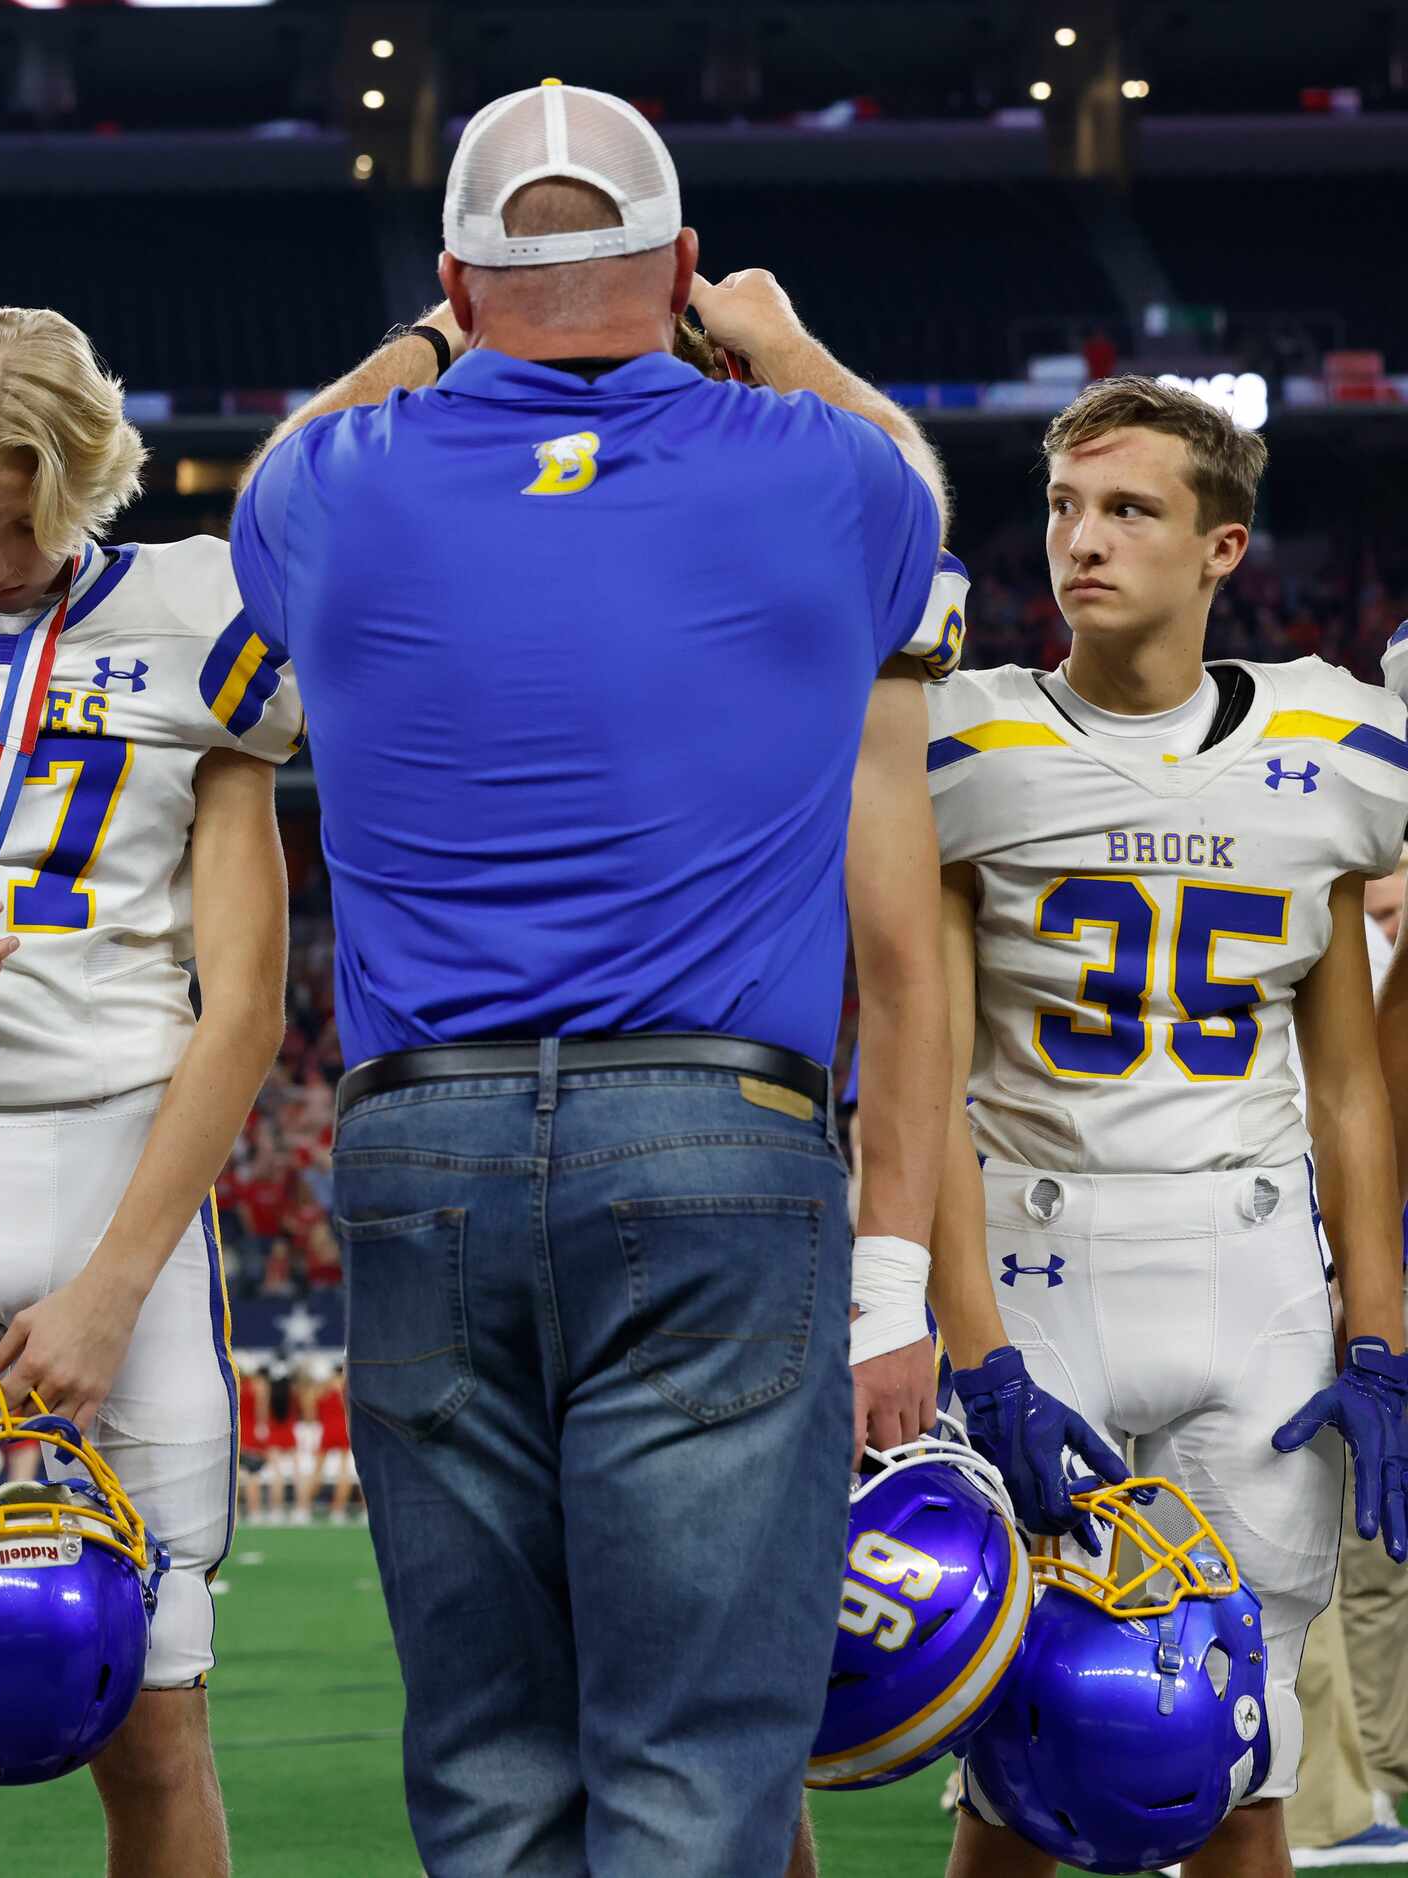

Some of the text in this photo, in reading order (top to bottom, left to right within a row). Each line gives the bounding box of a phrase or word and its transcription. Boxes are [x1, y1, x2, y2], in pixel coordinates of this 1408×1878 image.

[1106, 831, 1236, 868] BROCK
[1032, 874, 1292, 1082] 35
[0, 1546, 59, 1565] Riddell
